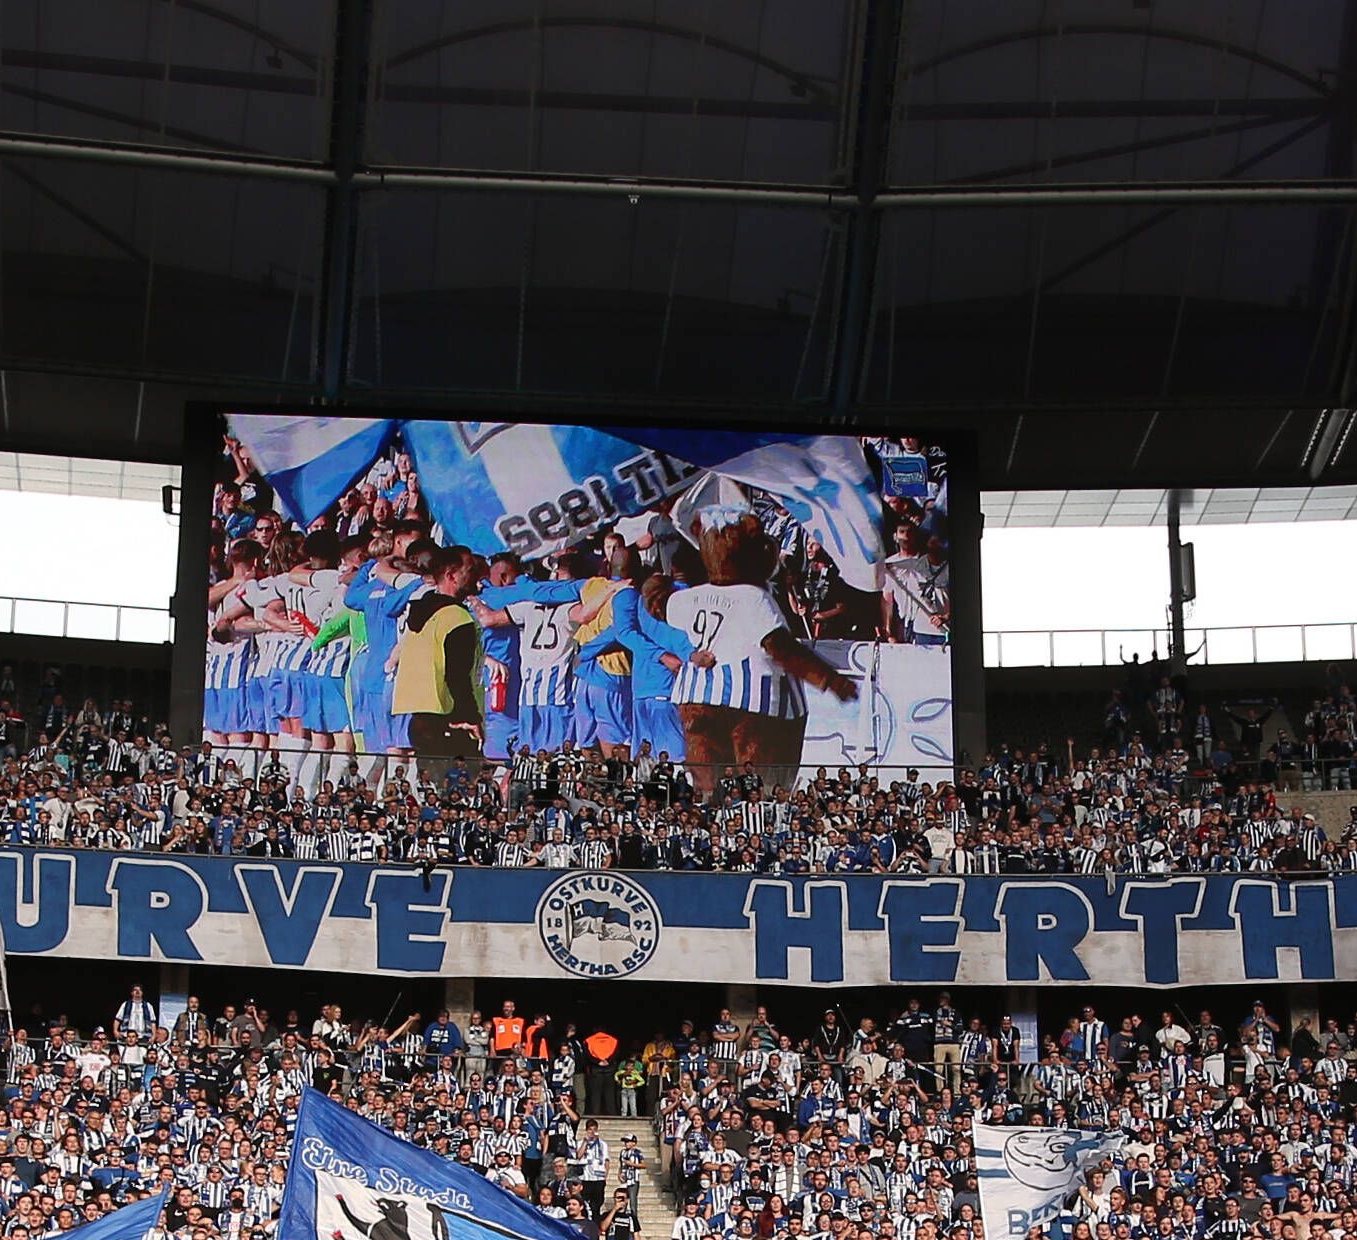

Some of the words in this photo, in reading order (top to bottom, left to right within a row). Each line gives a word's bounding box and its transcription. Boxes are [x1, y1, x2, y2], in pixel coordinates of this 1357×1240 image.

[548, 877, 648, 913] OSTKURVE
[547, 934, 620, 975] HERTHA
[622, 938, 652, 971] BSC
